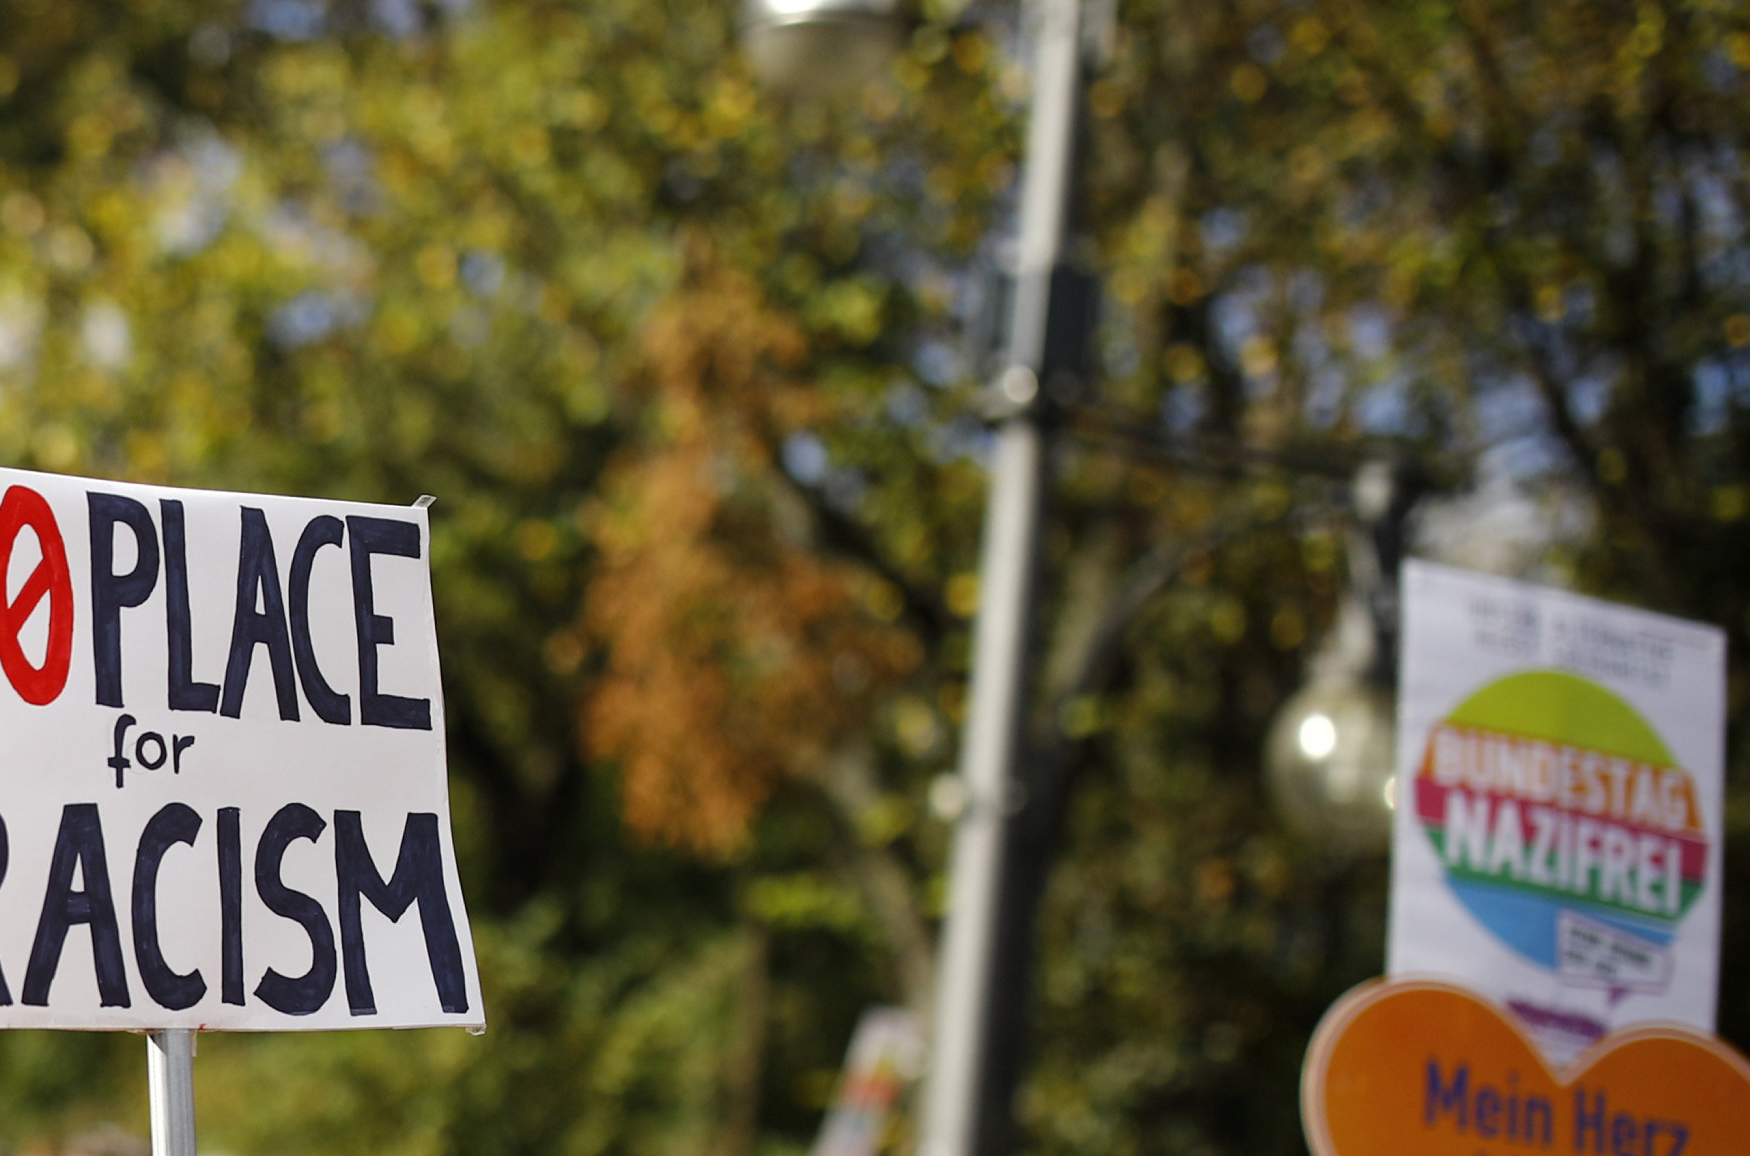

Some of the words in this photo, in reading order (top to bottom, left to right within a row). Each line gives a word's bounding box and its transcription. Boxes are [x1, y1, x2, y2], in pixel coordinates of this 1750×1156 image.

[87, 491, 432, 730] PLACE
[108, 714, 195, 788] for
[1432, 727, 1691, 831] BUNDESTAG
[1445, 792, 1684, 916] NAZIFREI
[1424, 1057, 1554, 1147] Mein
